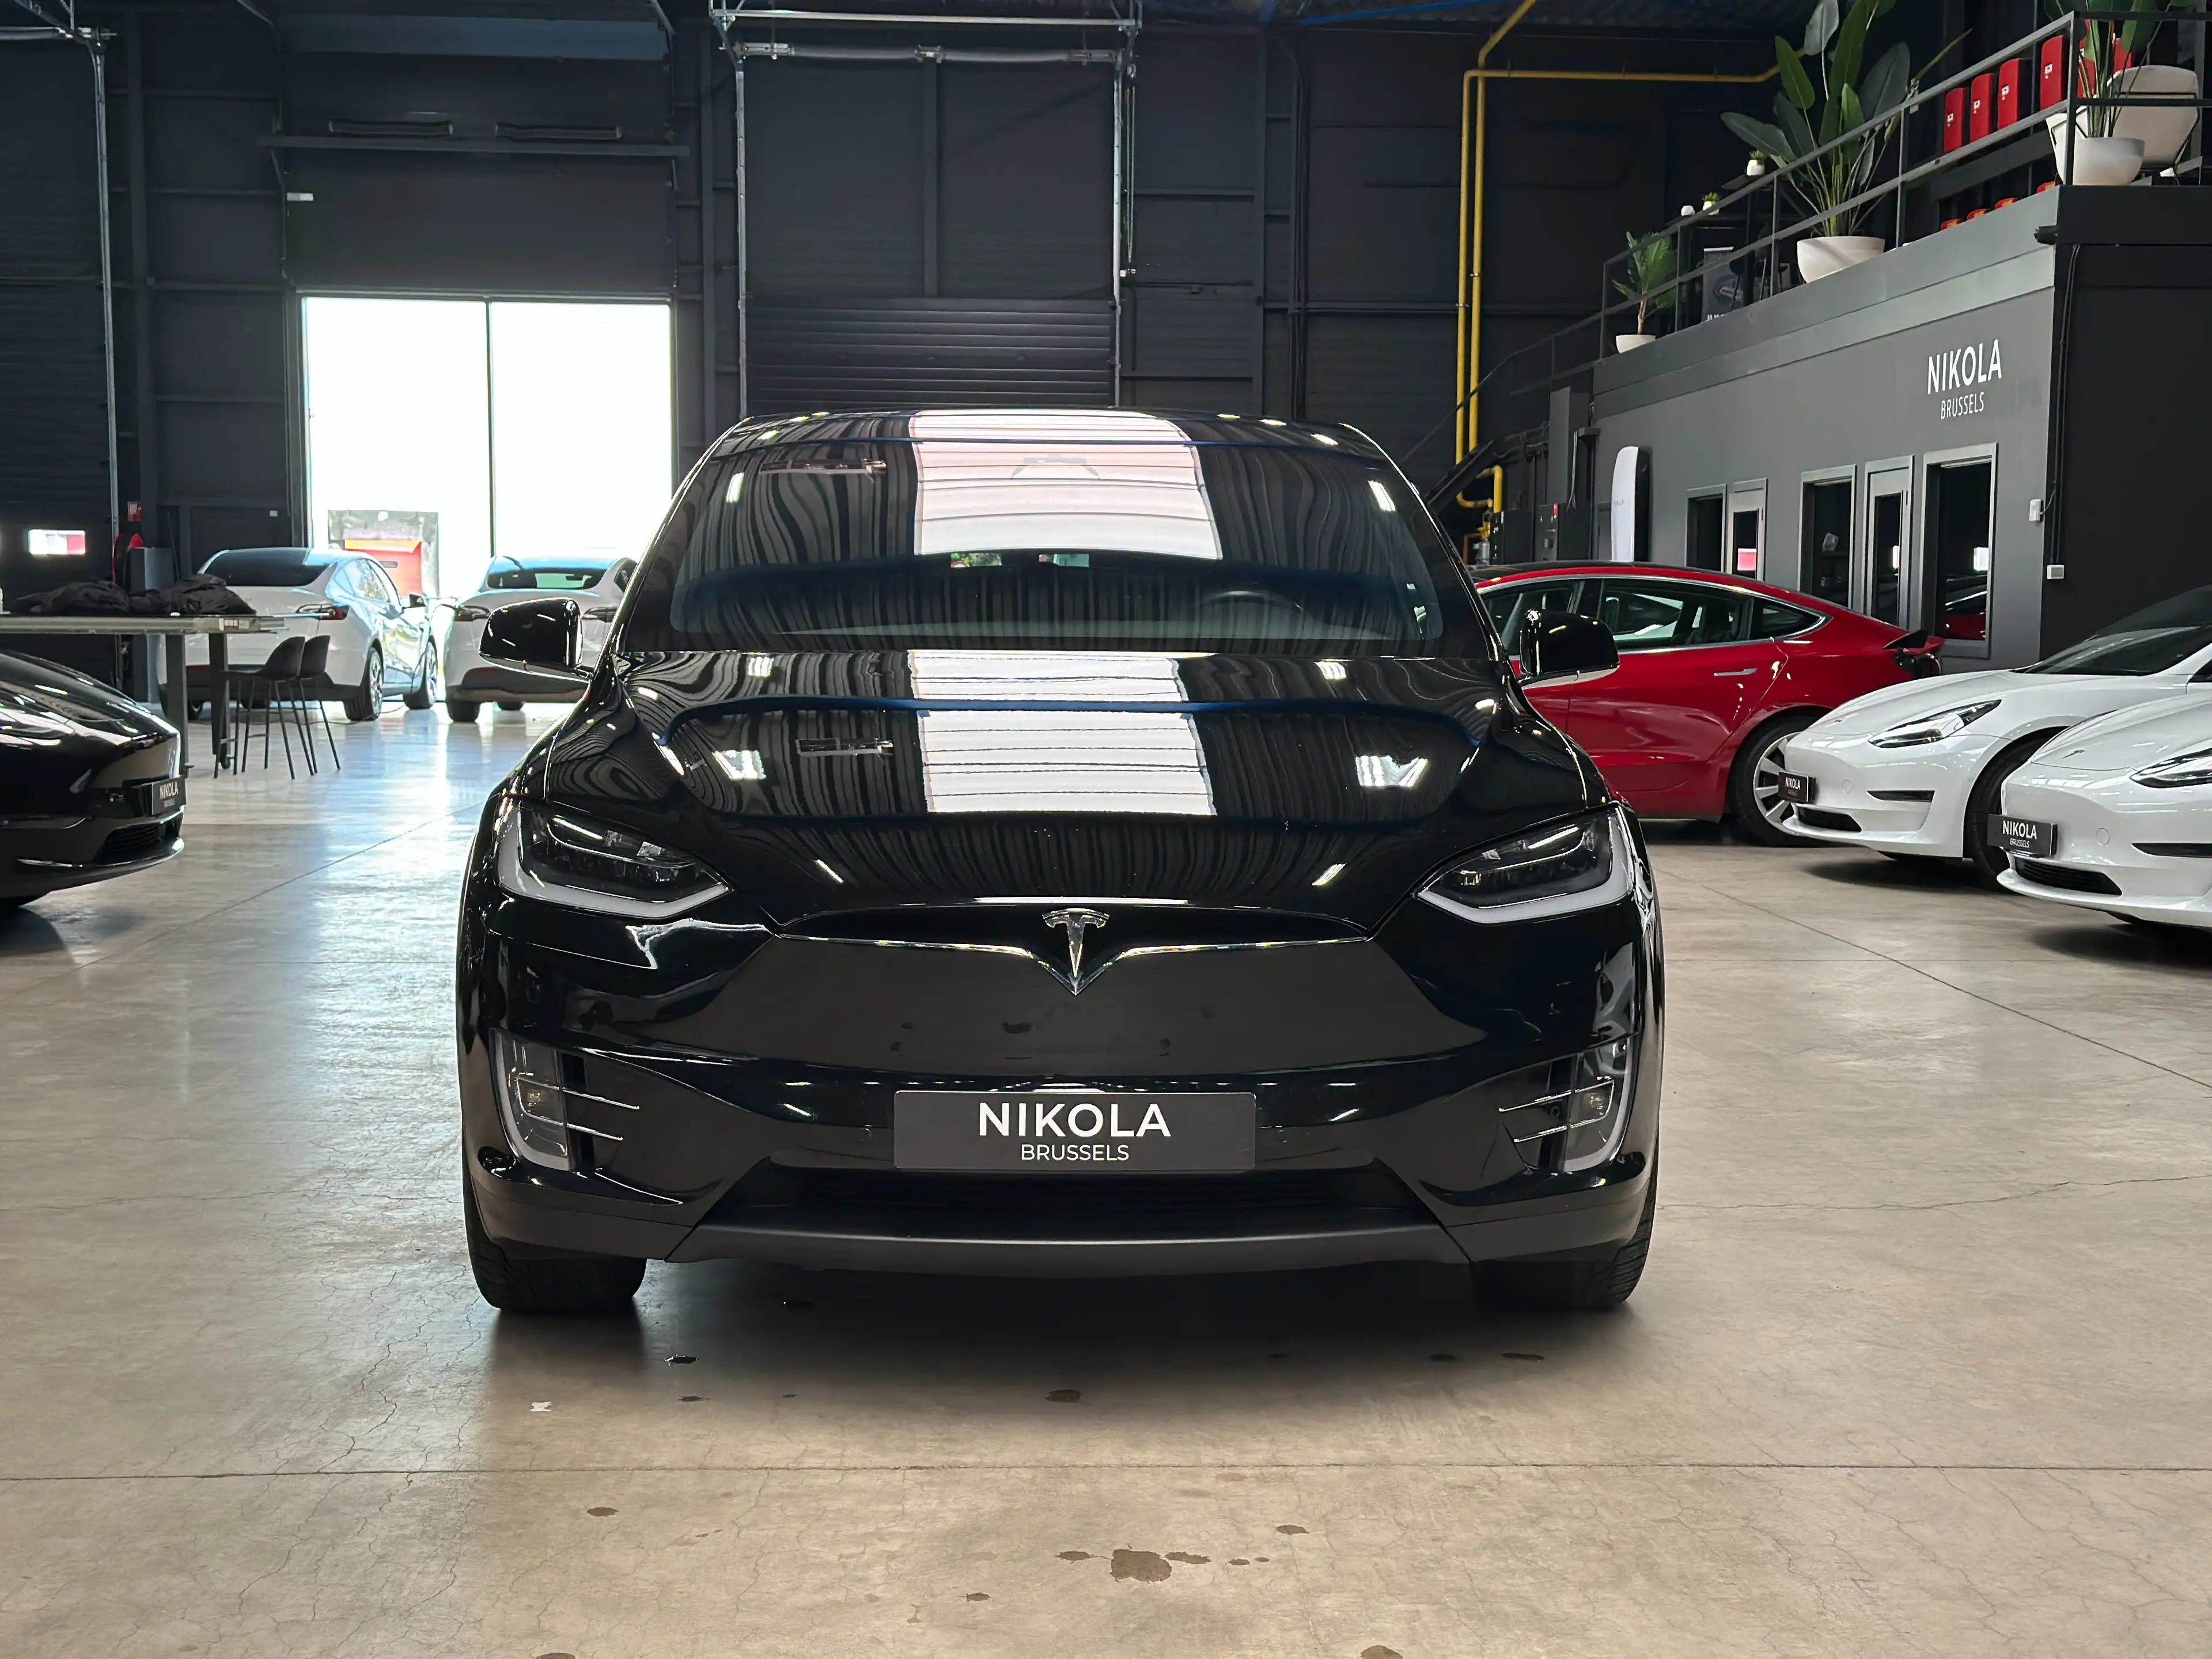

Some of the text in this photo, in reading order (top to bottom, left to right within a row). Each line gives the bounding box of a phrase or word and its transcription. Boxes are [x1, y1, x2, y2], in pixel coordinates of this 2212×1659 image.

[1927, 339, 2002, 394] NIKOLA
[1940, 392, 1984, 419] BRUSSELS
[160, 781, 179, 800] NIKOLA
[1785, 777, 1801, 790] NIKOLA
[2002, 820, 2037, 840] NIKOLA
[2009, 838, 2030, 848] BRUSSELS
[979, 1102, 1172, 1138] NIKOLA
[1021, 1144, 1129, 1161] BRUSSELS
